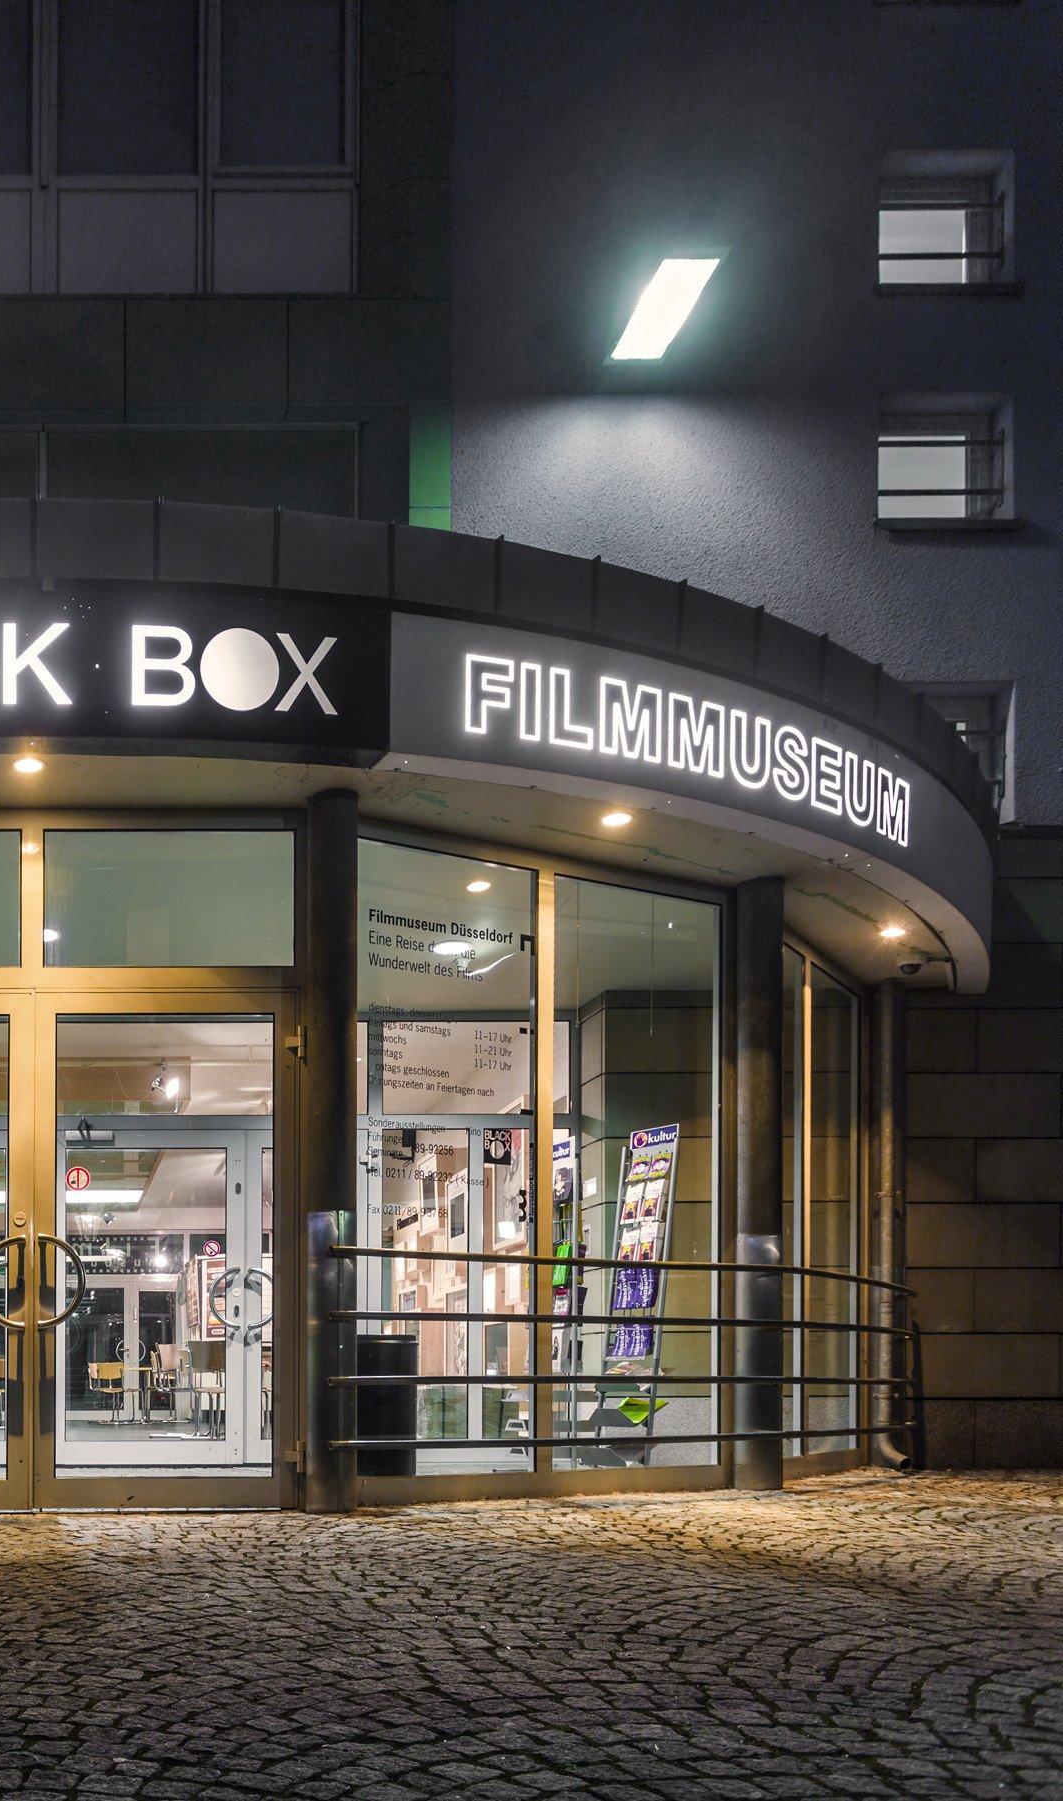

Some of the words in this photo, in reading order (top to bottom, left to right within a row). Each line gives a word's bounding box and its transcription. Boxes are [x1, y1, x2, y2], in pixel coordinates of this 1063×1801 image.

[131, 624, 339, 716] BOX
[464, 653, 911, 848] FILMMUSEUM
[369, 908, 447, 934] Filmmuseum
[451, 922, 514, 944] Düsseldorf
[369, 931, 392, 947] Eine
[396, 935, 425, 952] Reise
[369, 952, 432, 975] Wunderwelt
[434, 963, 453, 978] des
[399, 1022, 414, 1032] und
[415, 1025, 451, 1037] samstags
[499, 1033, 513, 1044] Uhr
[499, 1047, 513, 1058] Uhr
[371, 1062, 401, 1075] ontags
[403, 1065, 450, 1078] geschlossen
[499, 1061, 513, 1072] Uhr
[426, 1083, 435, 1091] an
[437, 1082, 475, 1097] Feiertagen
[477, 1087, 495, 1098] nach
[368, 1117, 446, 1135] Sonderausstellungen
[368, 1132, 404, 1147] Führunge
[485, 1130, 510, 1141] BLACK
[648, 1131, 677, 1144] kultur
[415, 1143, 454, 1156] 89-92256
[385, 1167, 406, 1179] 0211
